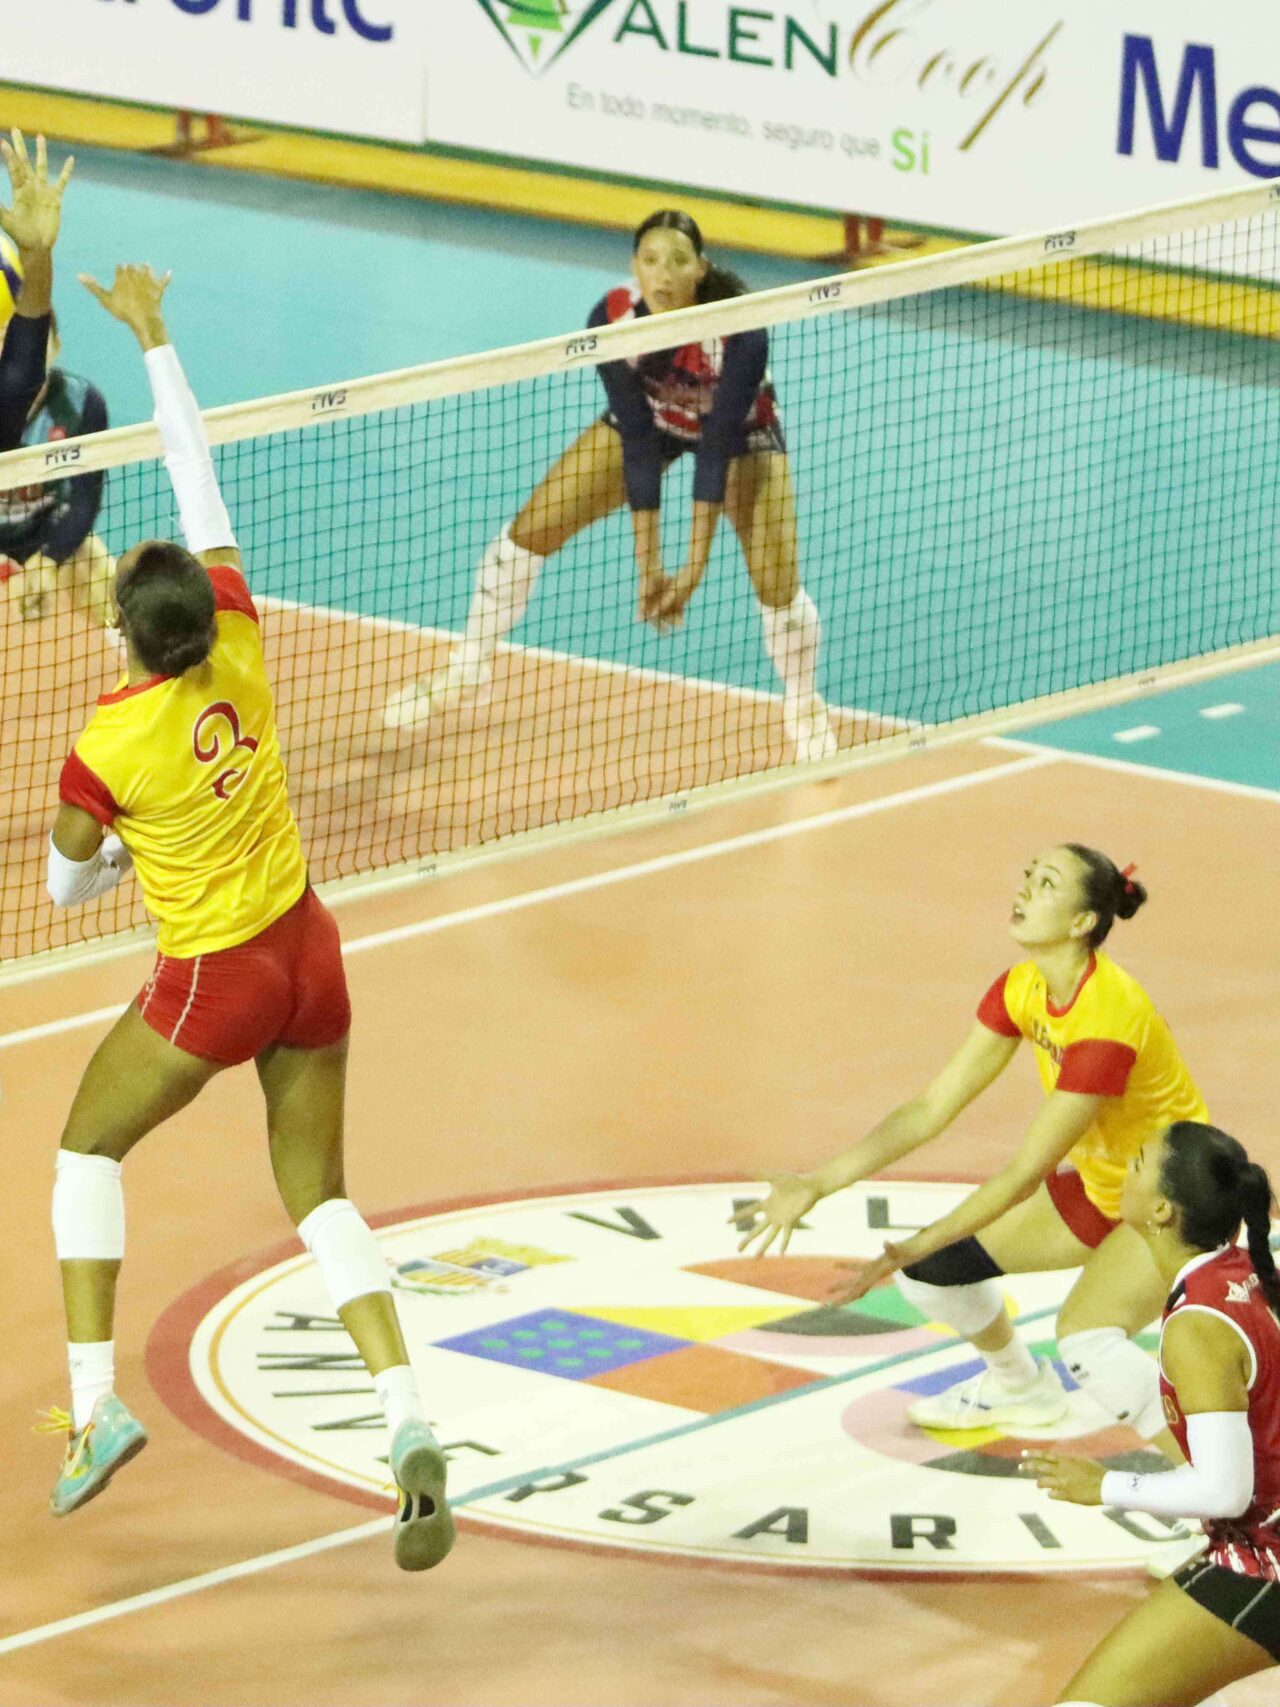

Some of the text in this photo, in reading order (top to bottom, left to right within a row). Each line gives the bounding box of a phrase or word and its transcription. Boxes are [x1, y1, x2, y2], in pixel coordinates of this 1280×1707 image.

[567, 82, 595, 112] En
[601, 89, 647, 120] todo
[762, 117, 833, 152] seguro
[840, 130, 880, 159] que
